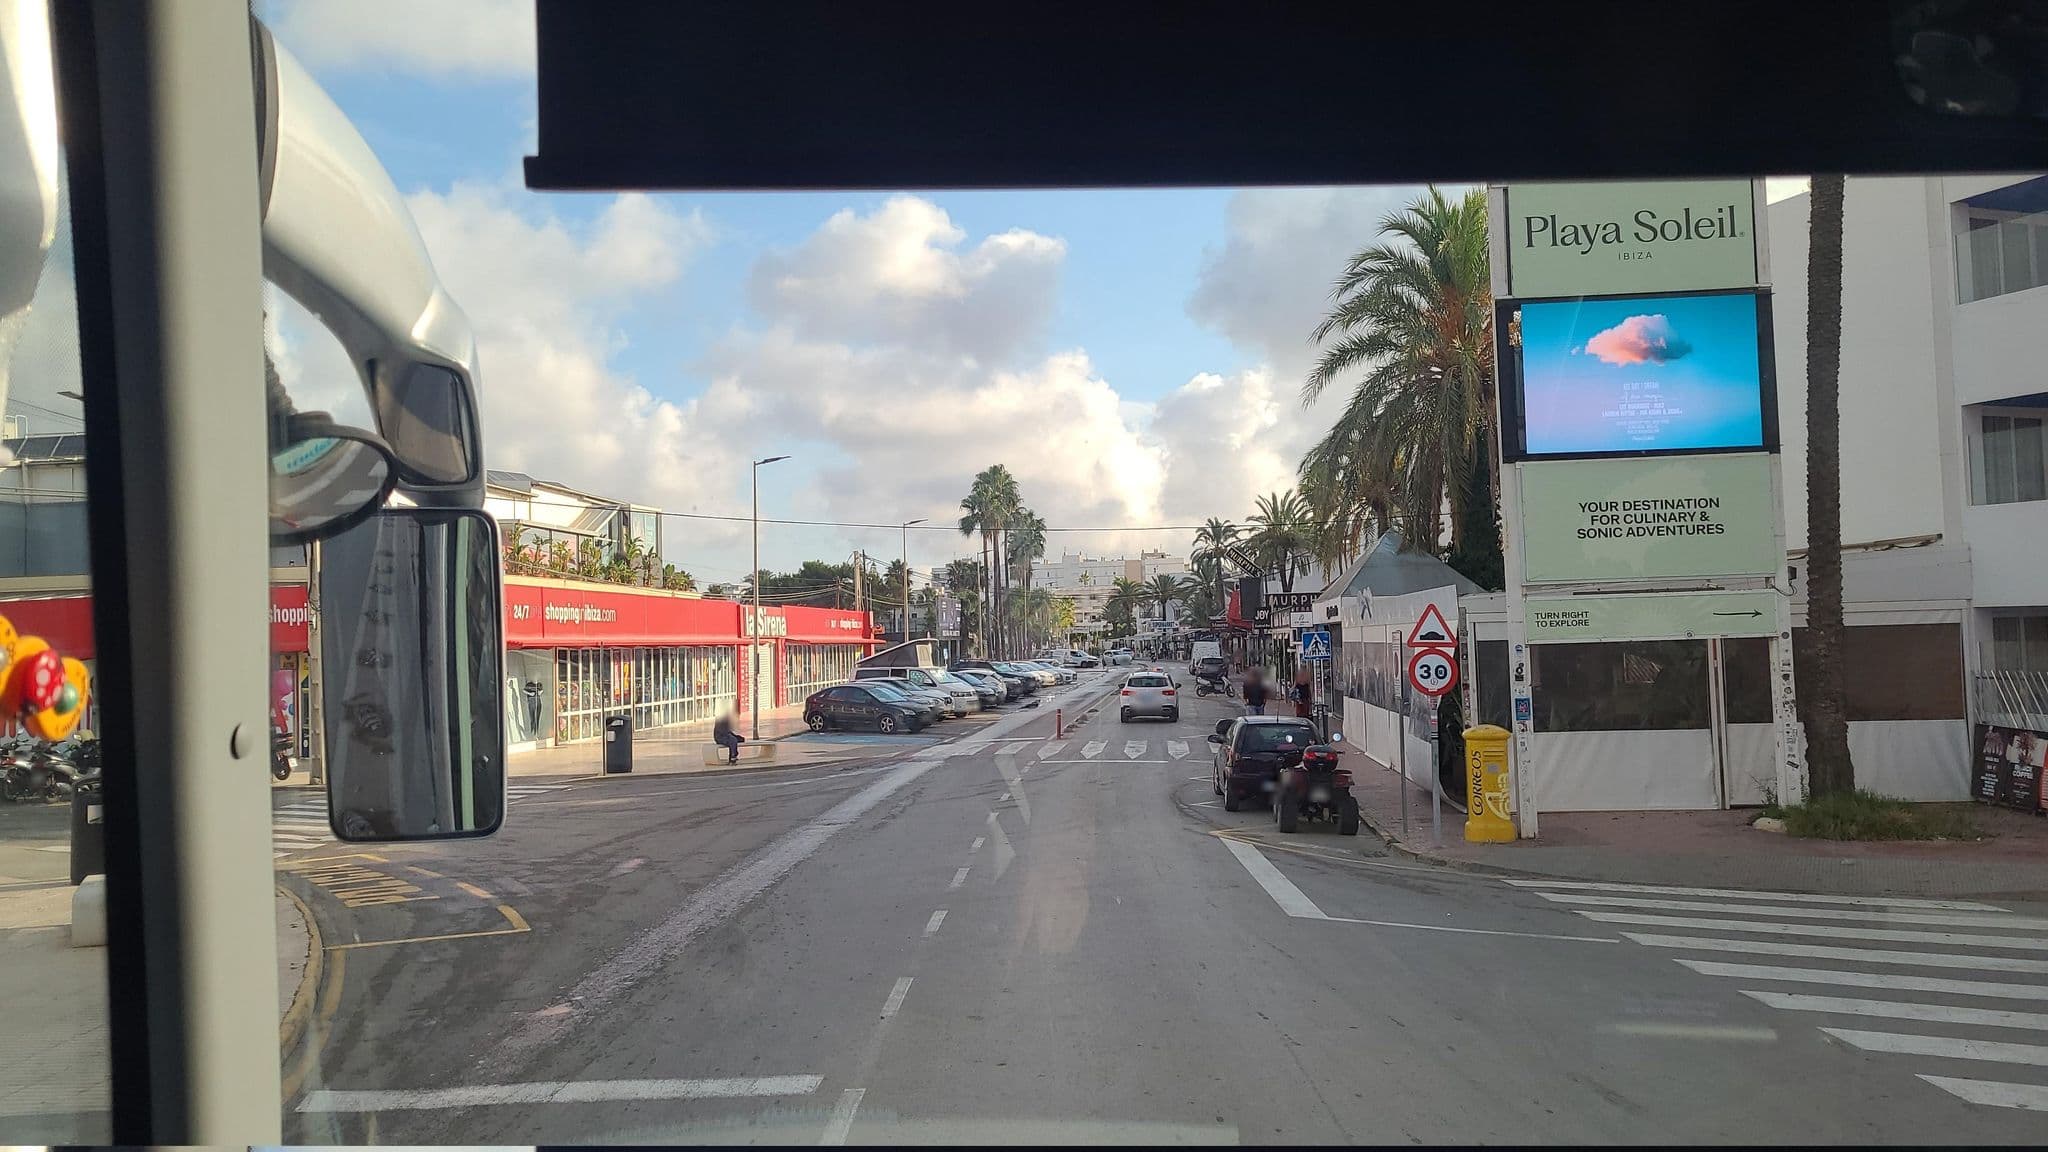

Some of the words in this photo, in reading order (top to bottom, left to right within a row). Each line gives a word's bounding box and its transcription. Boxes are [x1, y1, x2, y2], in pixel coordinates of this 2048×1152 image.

[1525, 214, 1624, 255] Playa
[1633, 205, 1737, 243] Soleil
[1618, 251, 1653, 261] IBIZA
[1578, 501, 1619, 513] YOUR
[1622, 497, 1720, 512] DESTINATION
[1591, 514, 1620, 525] FOR
[1623, 511, 1696, 525] CULINARY
[1699, 511, 1710, 522] &
[1577, 527, 1623, 539] SONIC
[1626, 523, 1725, 538] ADVENTURES
[513, 604, 530, 621] 24/7
[1534, 612, 1560, 620] TURN
[1562, 611, 1590, 619] RIGHT
[1535, 620, 1548, 628] TO
[1550, 619, 1590, 628] EXPLORE
[1419, 664, 1448, 680] 30
[1471, 750, 1484, 816] CORREOS
